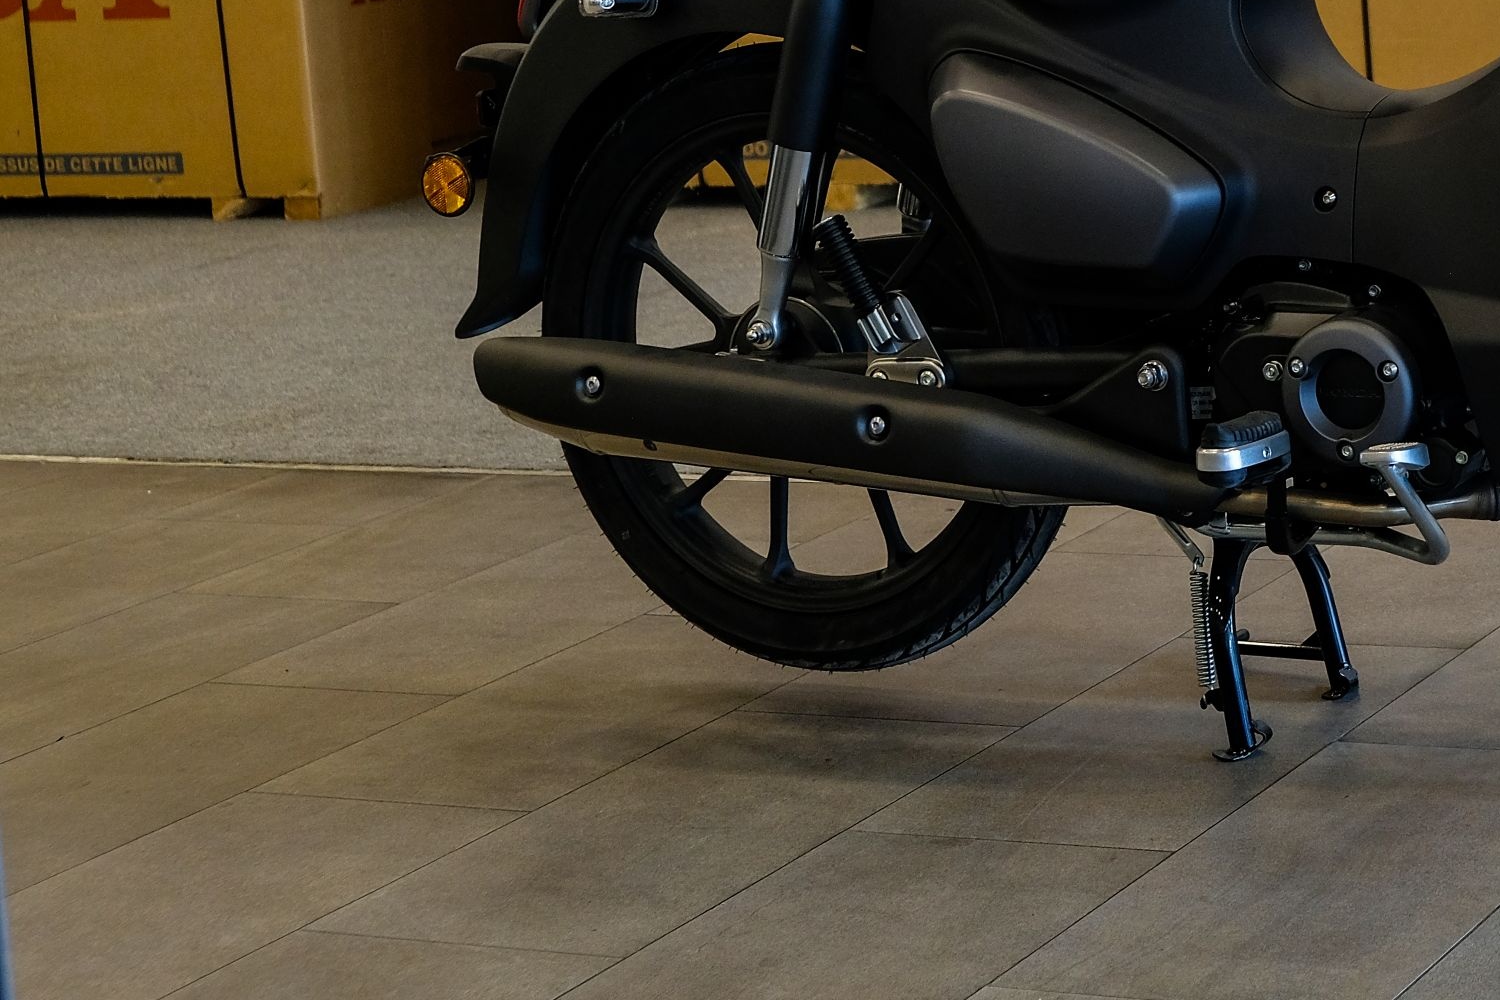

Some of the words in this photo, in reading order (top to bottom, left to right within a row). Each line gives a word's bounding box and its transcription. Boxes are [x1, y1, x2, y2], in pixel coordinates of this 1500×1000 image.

[45, 157, 66, 173] DE
[70, 156, 123, 173] CETTE
[128, 156, 178, 172] LIGNE
